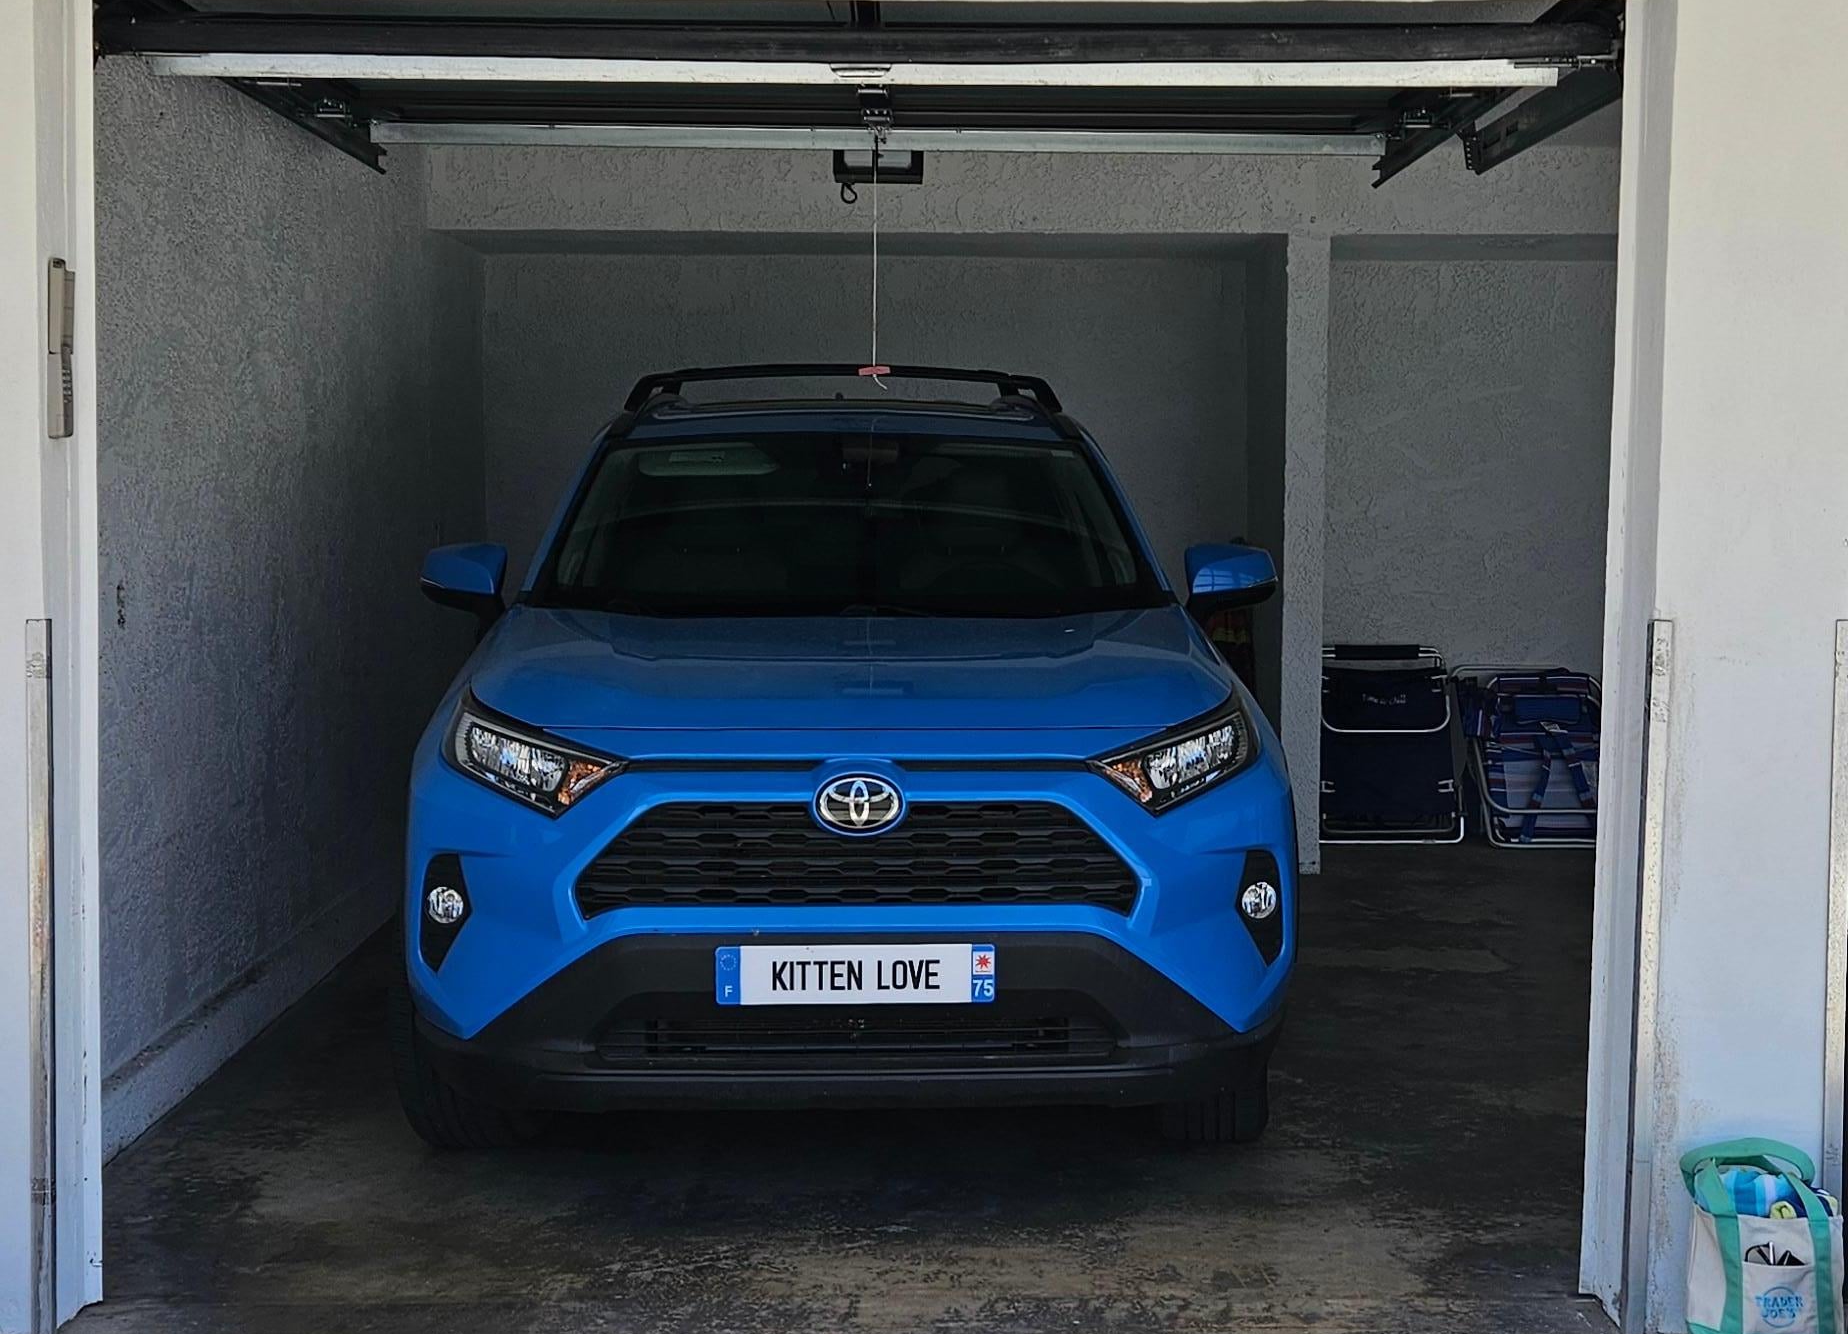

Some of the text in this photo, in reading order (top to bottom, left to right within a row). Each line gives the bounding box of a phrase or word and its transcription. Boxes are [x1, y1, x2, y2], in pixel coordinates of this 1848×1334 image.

[772, 959, 941, 991] KITTEN LOVE
[724, 985, 733, 998] F
[972, 979, 994, 997] 75
[1755, 1295, 1804, 1308] TRADER
